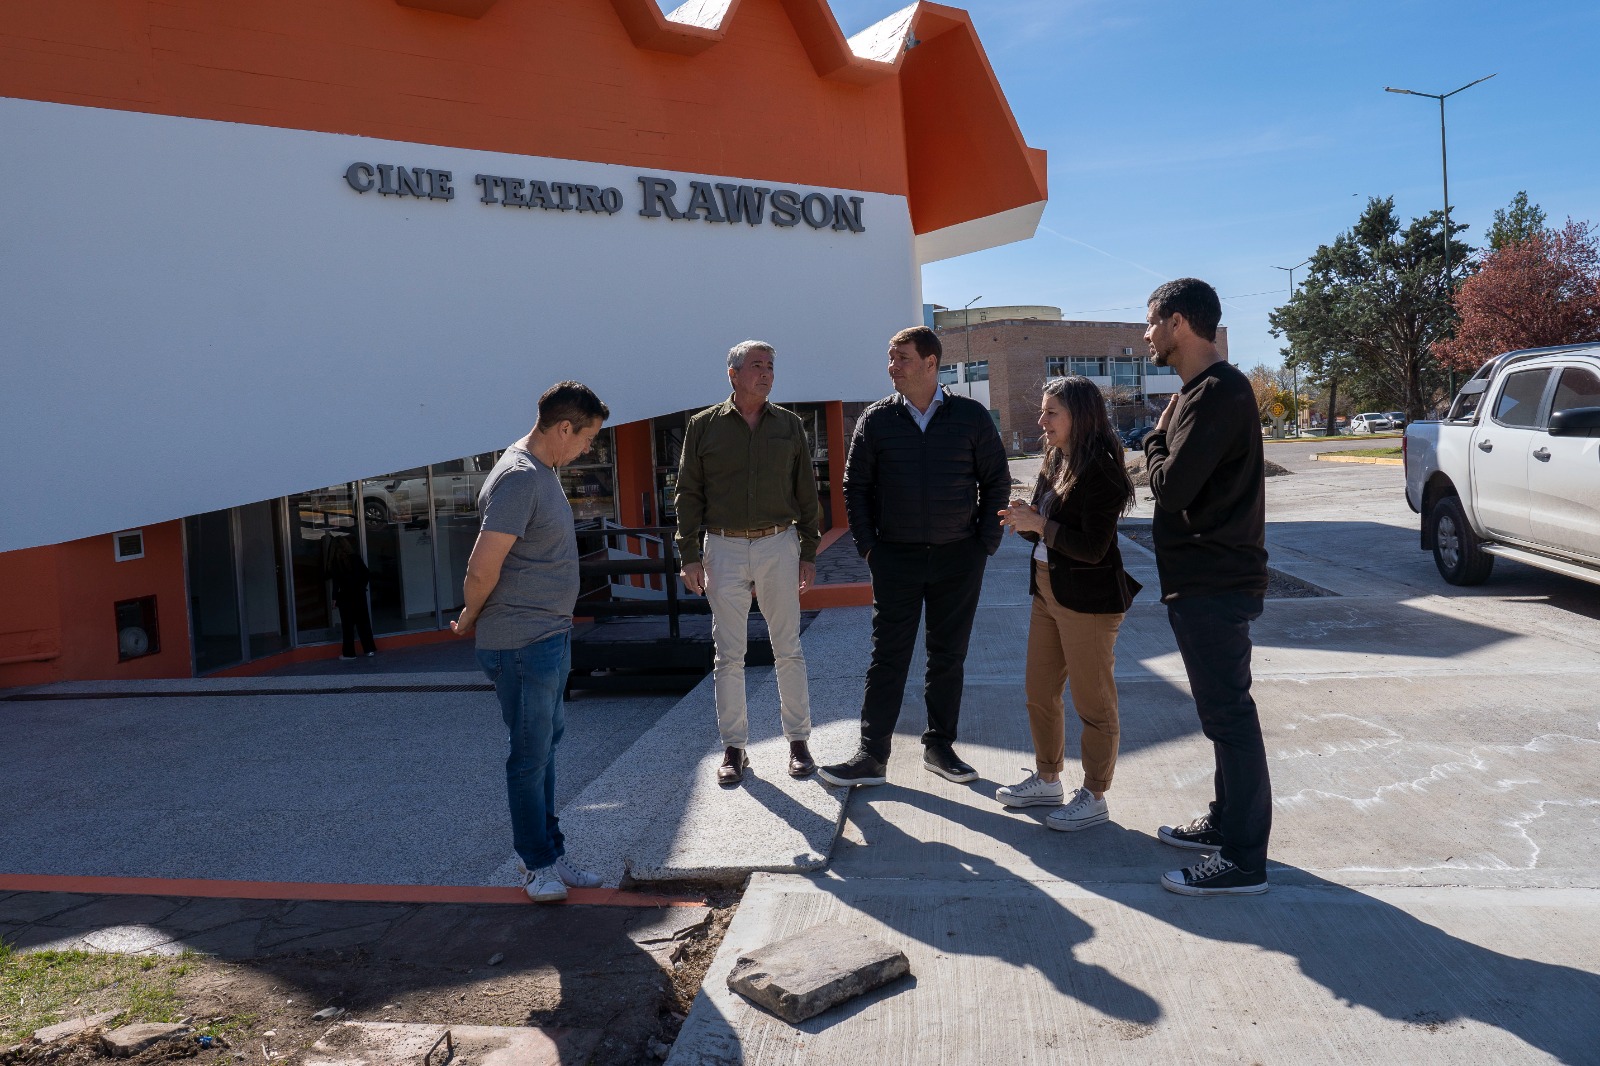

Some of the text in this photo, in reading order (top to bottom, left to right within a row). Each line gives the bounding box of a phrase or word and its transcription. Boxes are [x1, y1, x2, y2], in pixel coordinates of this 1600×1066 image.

[345, 161, 866, 232] CINE TEATRO RAWSON
